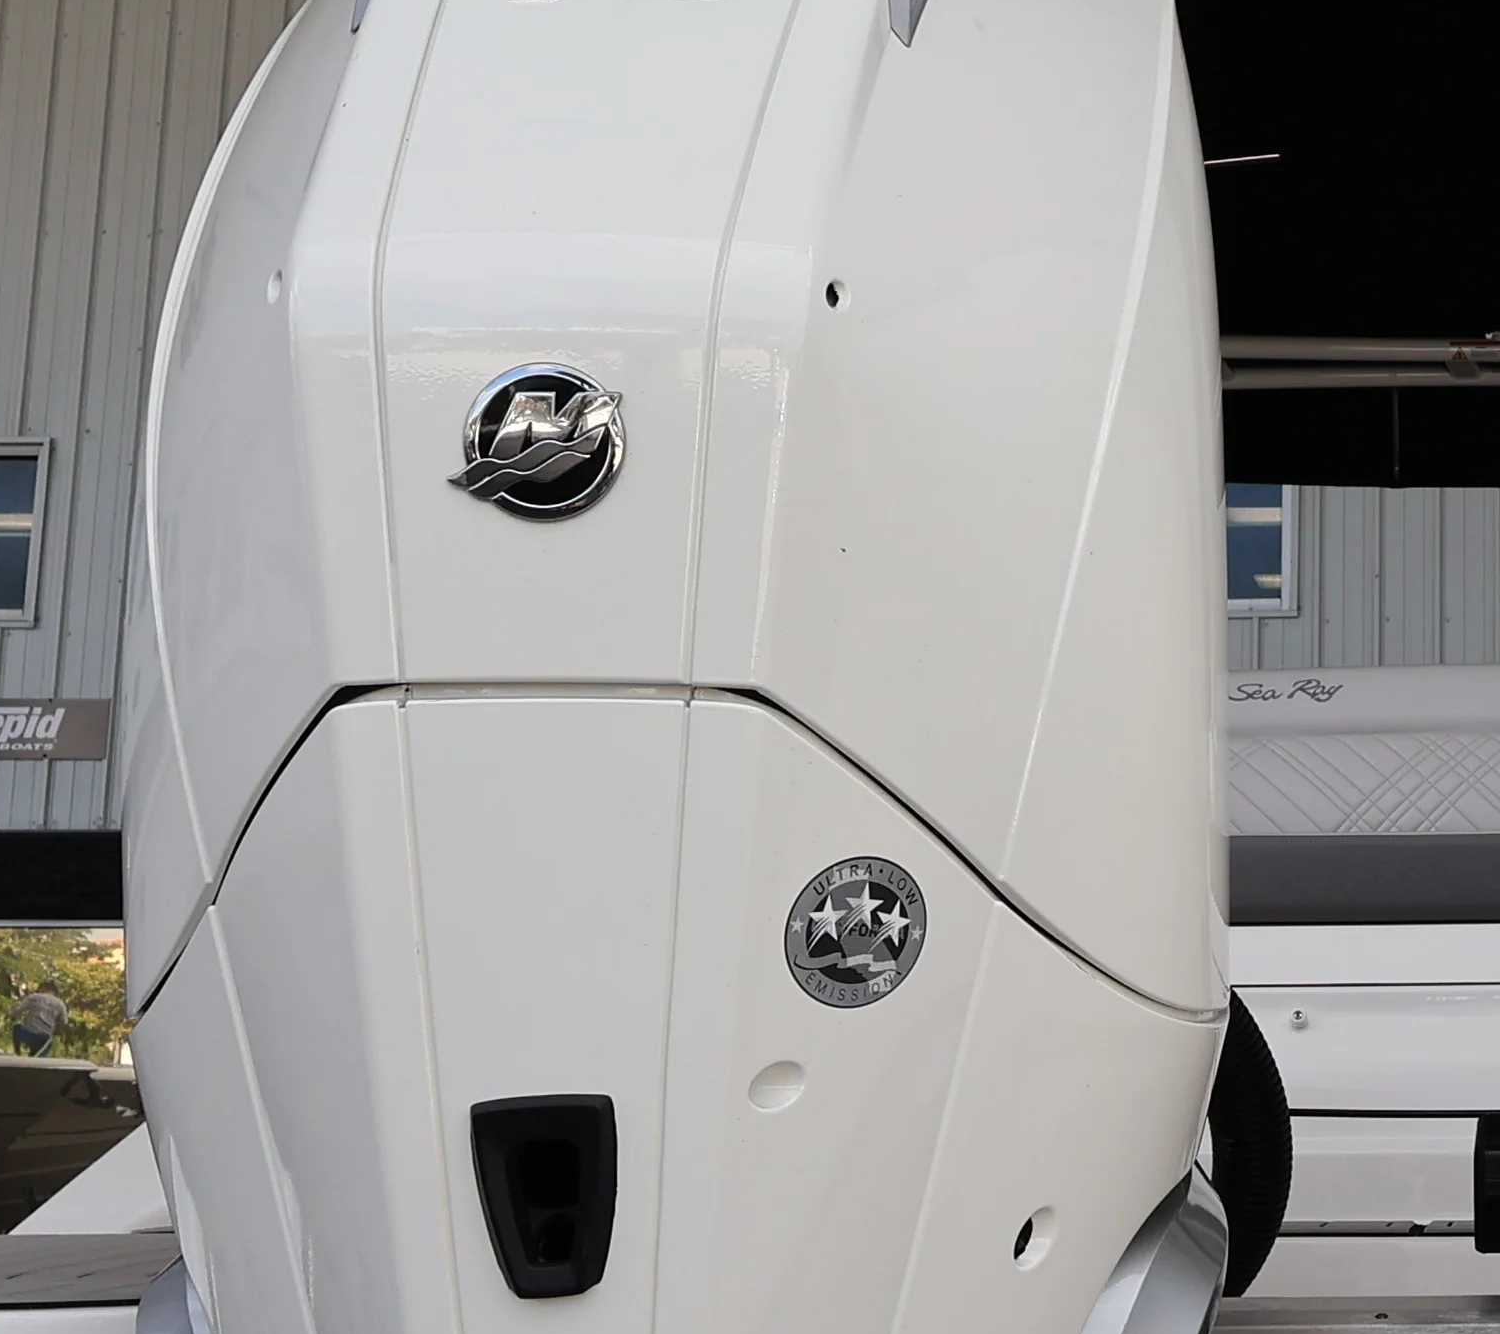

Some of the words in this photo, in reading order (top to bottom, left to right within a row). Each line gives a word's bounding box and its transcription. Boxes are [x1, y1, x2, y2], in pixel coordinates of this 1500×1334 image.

[1228, 683, 1284, 702] Sea
[1286, 678, 1344, 703] Ray
[812, 863, 873, 896] ULTRA
[887, 870, 919, 906] LOW
[805, 972, 895, 1002] EMISSION
